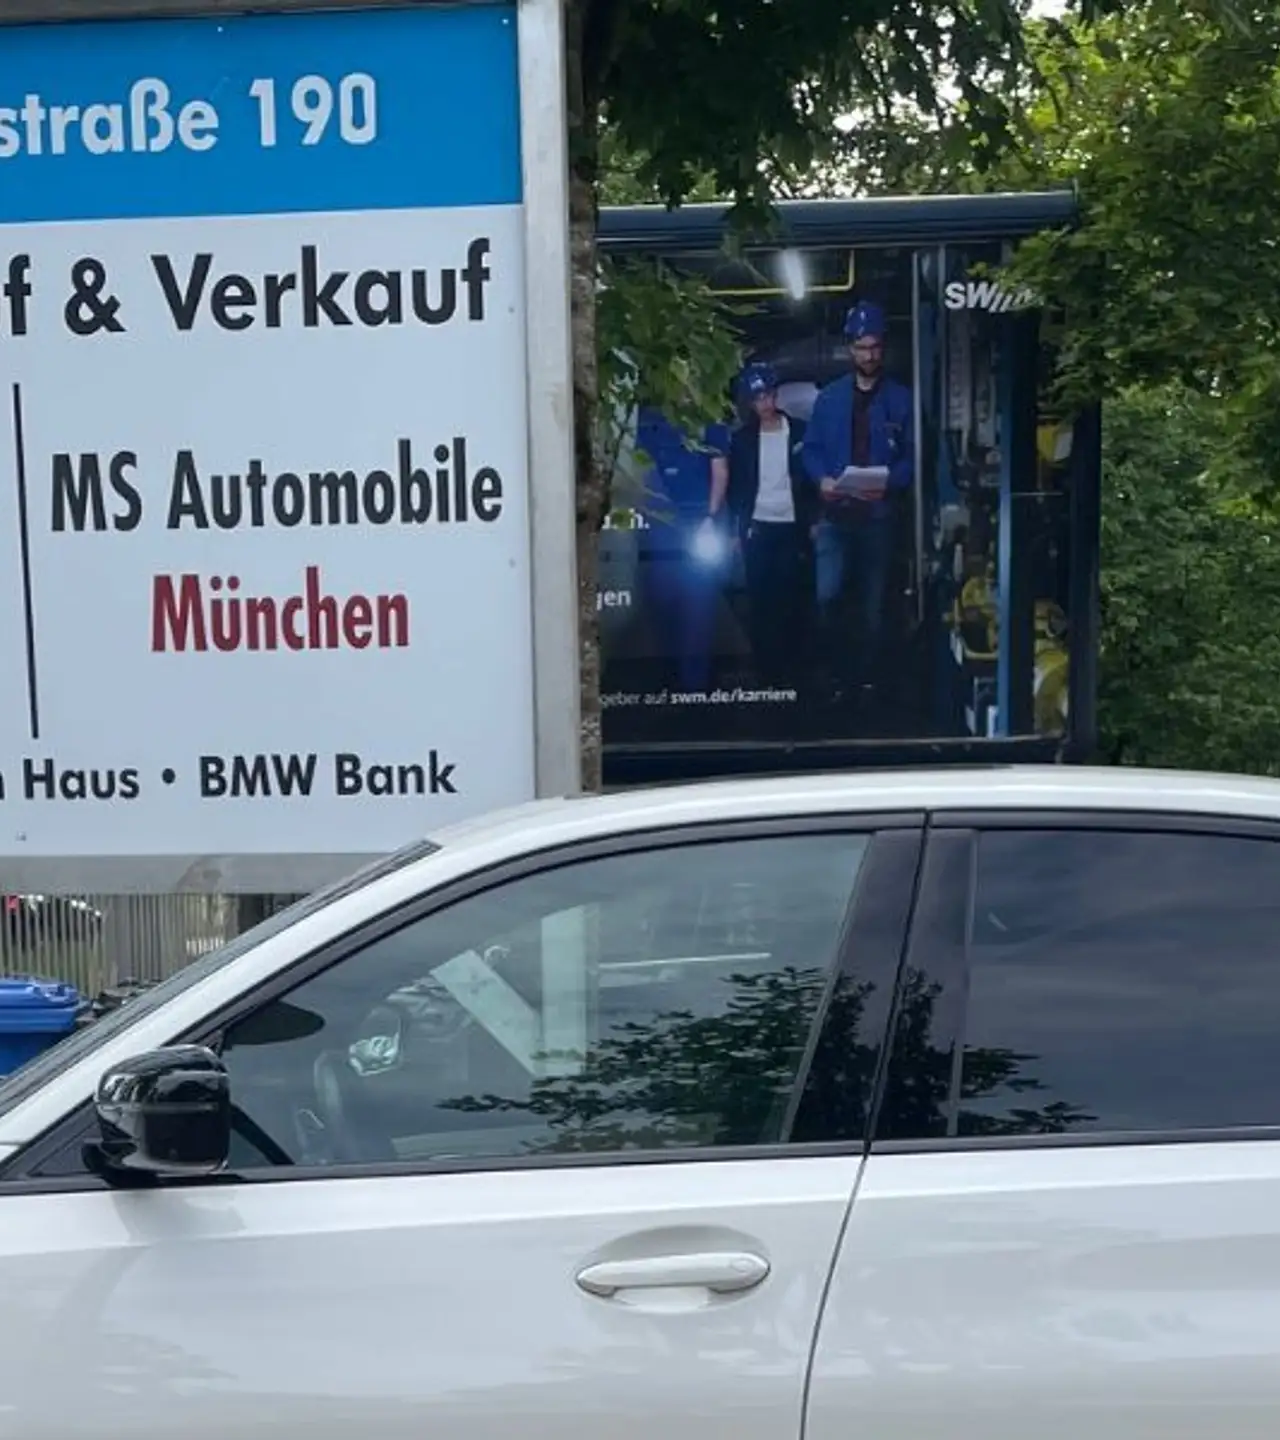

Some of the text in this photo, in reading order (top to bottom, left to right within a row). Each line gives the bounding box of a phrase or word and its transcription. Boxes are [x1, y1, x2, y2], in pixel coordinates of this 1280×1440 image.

[248, 73, 377, 146] 190
[64, 257, 126, 336] &
[150, 237, 491, 331] Verkauf
[51, 436, 503, 532] MS Automobile
[152, 568, 409, 653] München
[670, 686, 797, 705] swm.de/karriere
[23, 758, 140, 800] Haus
[199, 753, 317, 798] BMW
[335, 749, 458, 796] Bank
